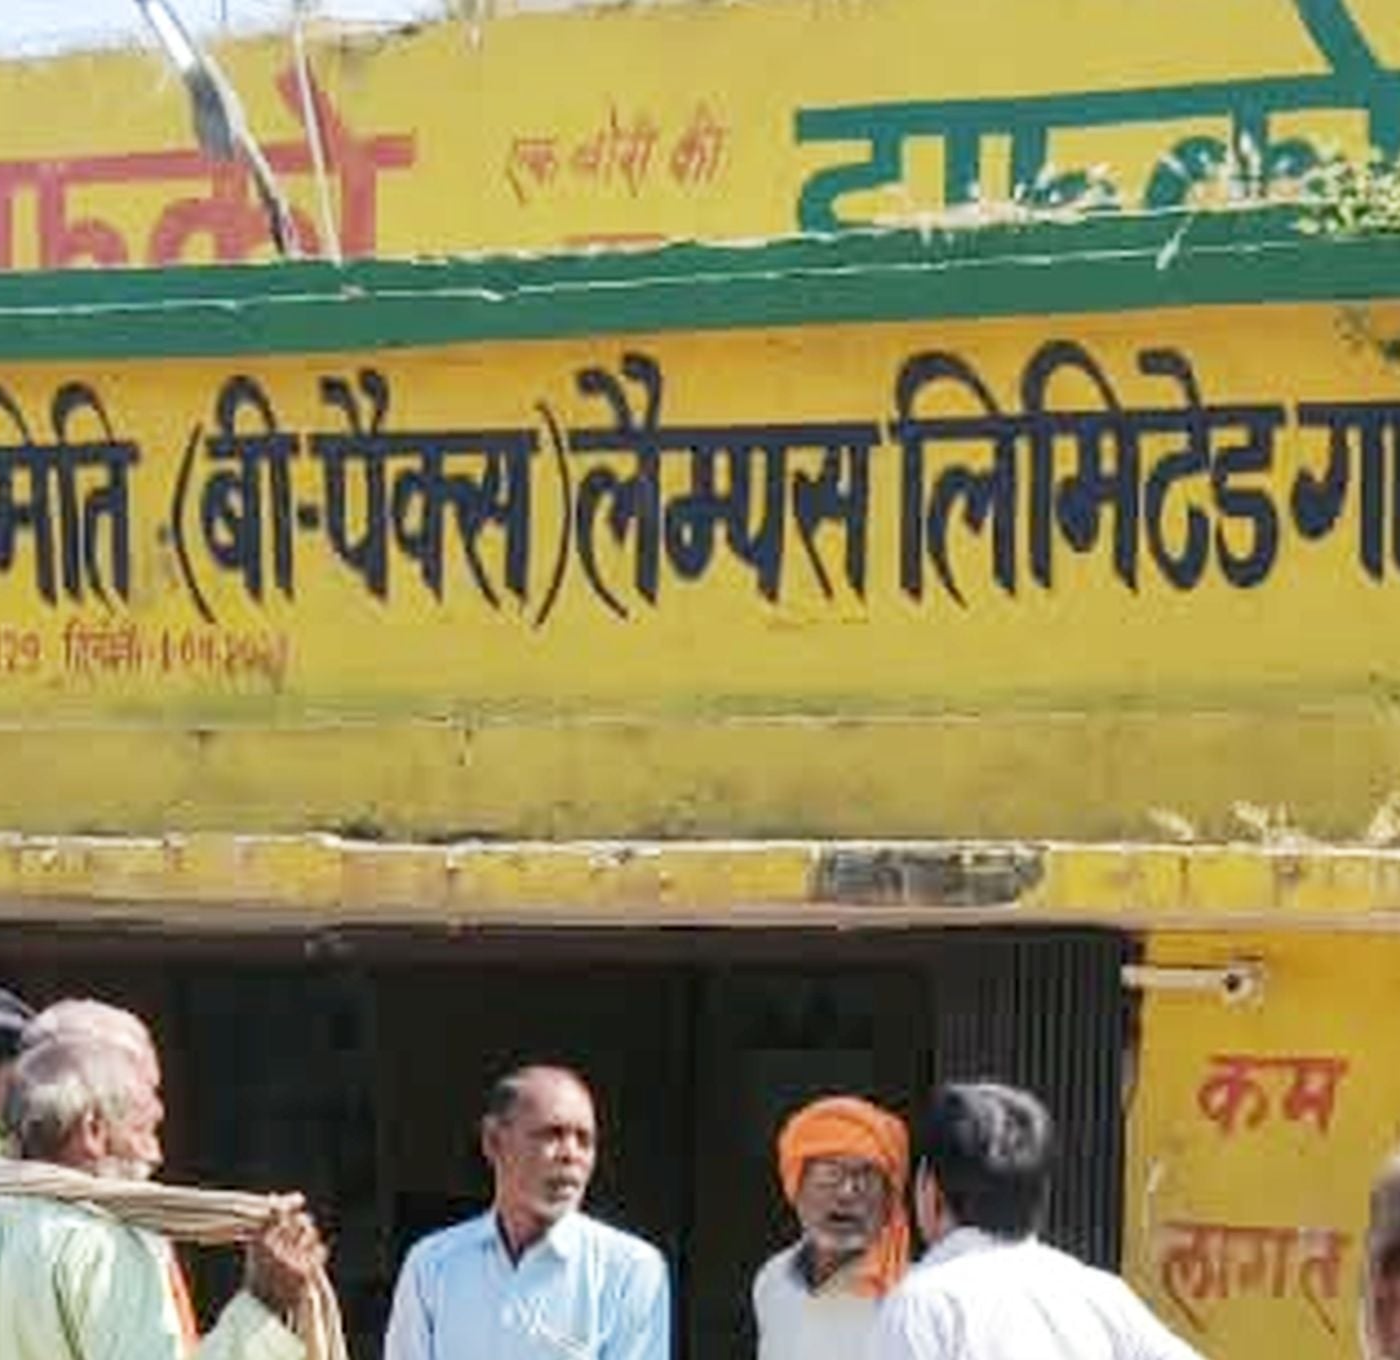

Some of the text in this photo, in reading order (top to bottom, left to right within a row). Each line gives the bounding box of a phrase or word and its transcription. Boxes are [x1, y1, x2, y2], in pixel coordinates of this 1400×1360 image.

[889, 339, 1286, 608] लिमिटेड
[1197, 1055, 1348, 1137] कम
[1162, 1221, 1353, 1333] लागत
